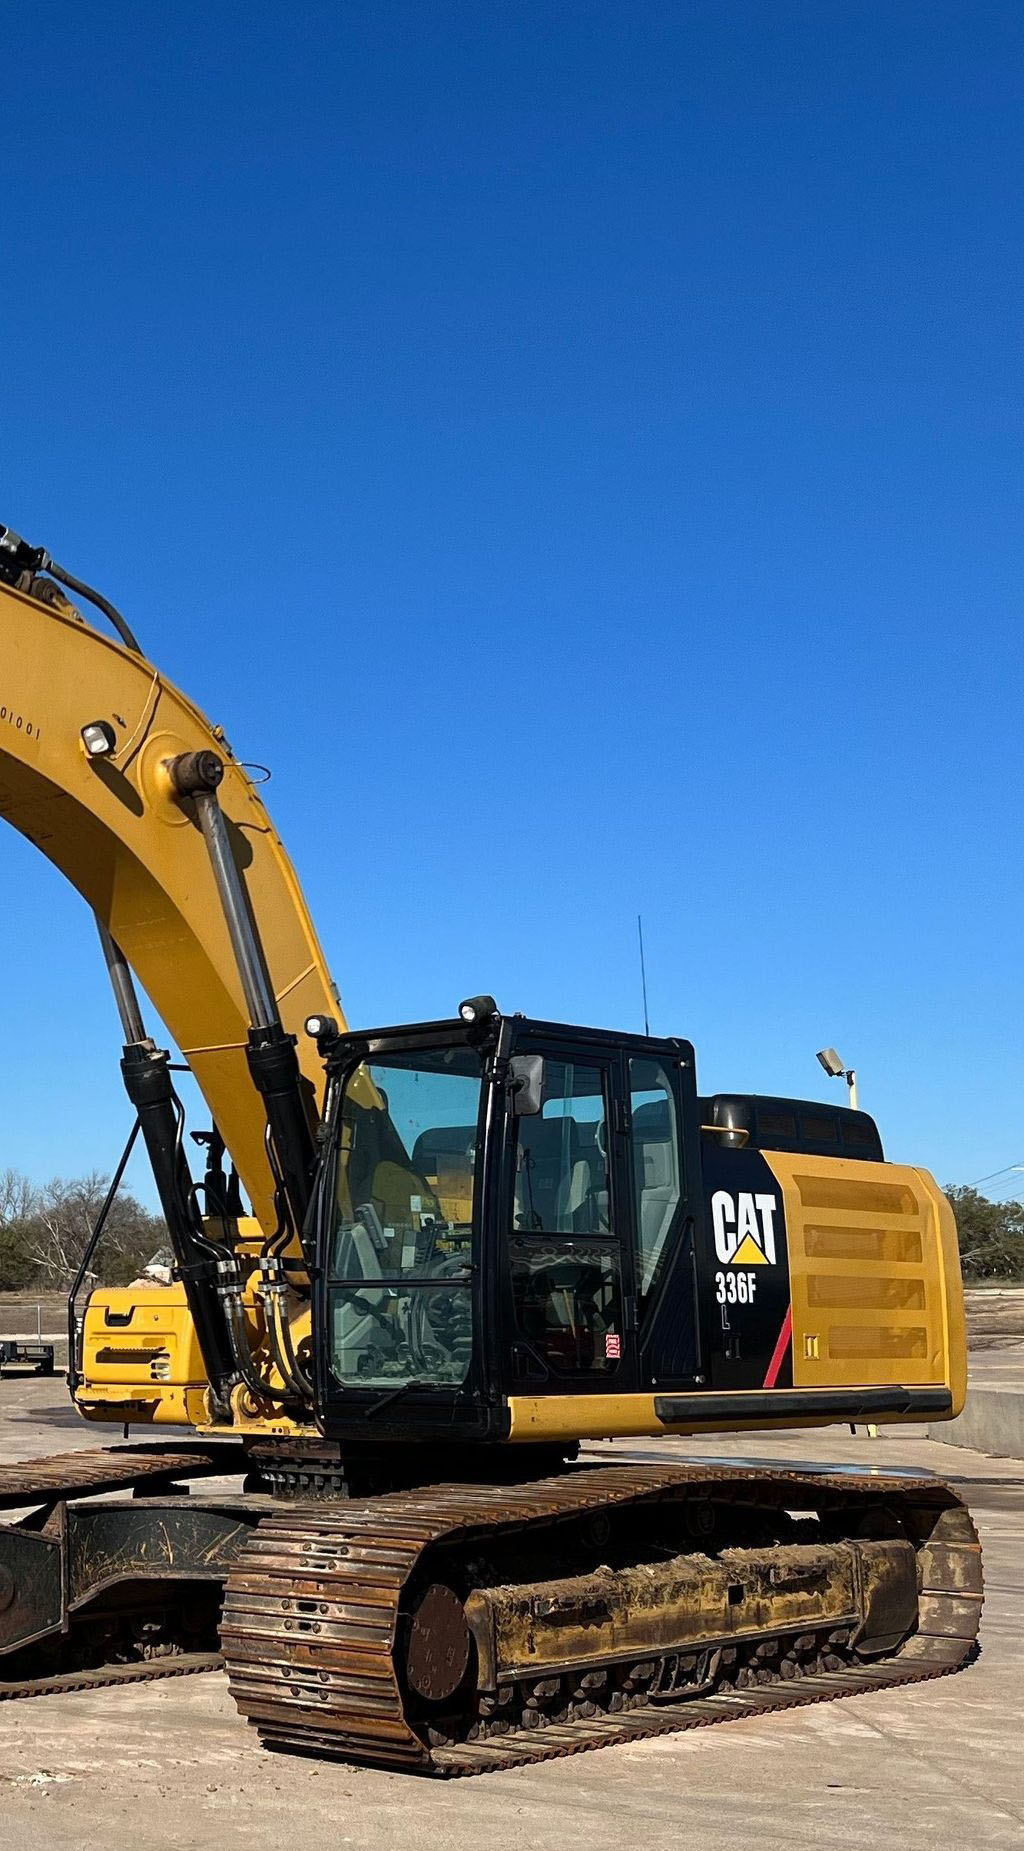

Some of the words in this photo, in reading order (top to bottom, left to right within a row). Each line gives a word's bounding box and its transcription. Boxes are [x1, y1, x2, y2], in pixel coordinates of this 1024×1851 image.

[712, 1190, 776, 1265] CAT
[716, 1272, 756, 1303] 336F
[721, 1304, 730, 1330] L
